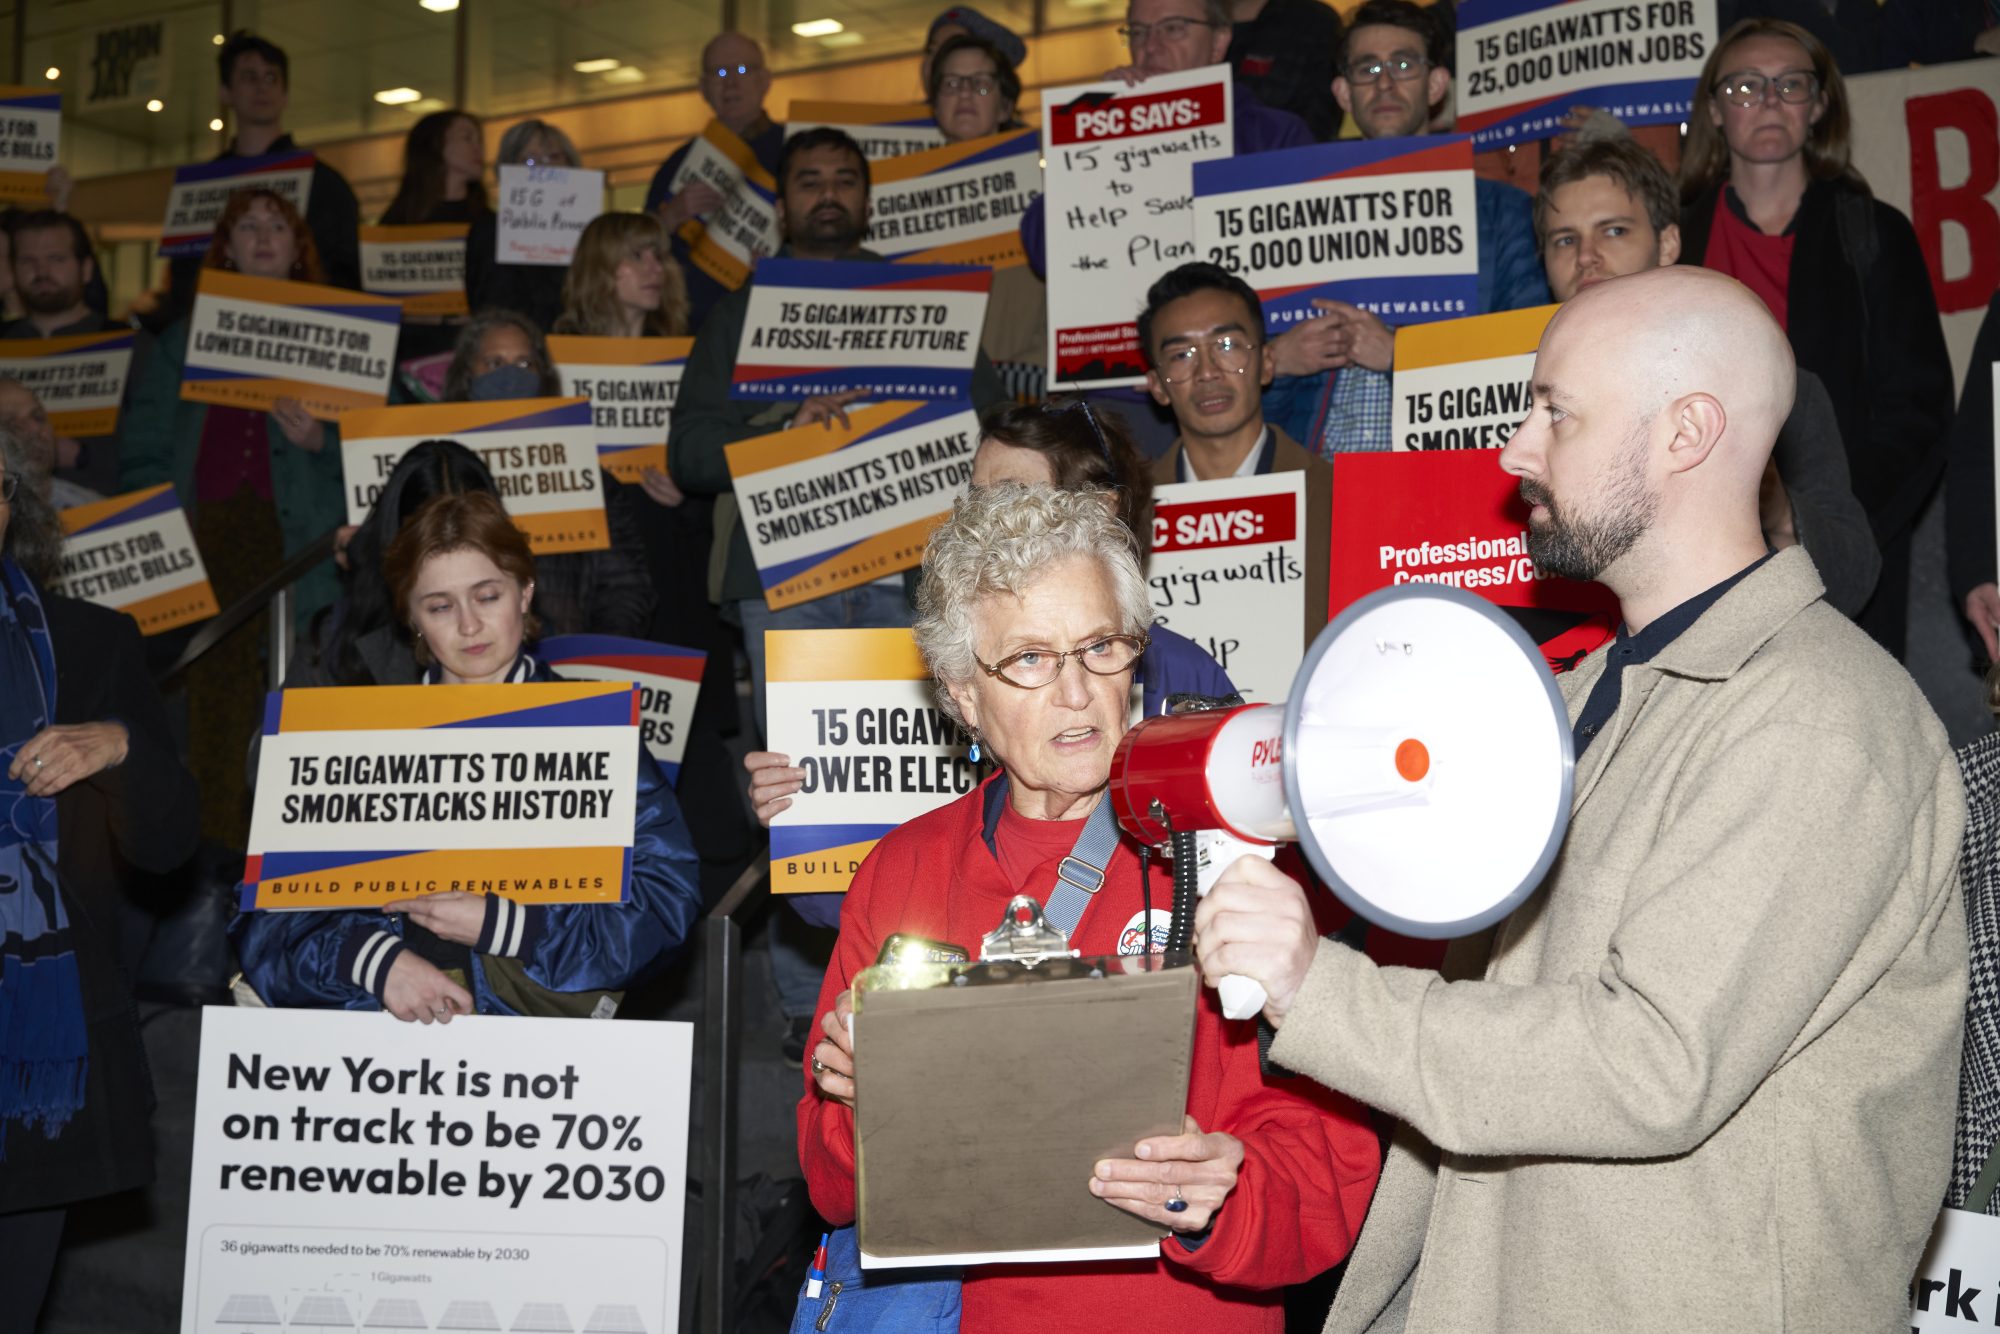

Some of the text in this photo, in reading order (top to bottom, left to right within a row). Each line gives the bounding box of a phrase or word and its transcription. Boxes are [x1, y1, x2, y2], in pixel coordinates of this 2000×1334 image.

[1476, 1, 1694, 62] 15 GIGAWATTS FOR
[1468, 33, 1705, 96] 25,000 UNION JOBS
[8, 119, 37, 138] FOR
[1075, 98, 1201, 139] PSC SAYS:
[1604, 102, 1693, 117] NEWABLE
[11, 141, 54, 160] BILLS
[1064, 131, 1220, 171] 15 gigawatts
[876, 171, 1017, 217] GIGAWATTS FOR
[1107, 180, 1133, 196] to
[904, 203, 988, 236] ELECTRIC
[1067, 206, 1127, 229] Help
[1216, 188, 1452, 238] 15 GIGAWATTS FOR
[1209, 224, 1464, 275] 25,000 UNION JOBS
[780, 303, 948, 325] 15 GIGAWATTS TO
[1270, 299, 1466, 324] PUBLI NEWABLES
[217, 310, 371, 352] 15 GIGAWATTS FOR
[752, 328, 970, 351] A FOSSIL-FREE FUTURE
[194, 332, 388, 380] LOWER ELECTRIC BILLS
[739, 382, 786, 395] BUILD
[1406, 393, 1433, 424] 15
[527, 443, 567, 468] FOR
[747, 432, 972, 517] 15 GIGAWATTS TO MAKE
[537, 468, 595, 492] BILLS
[757, 460, 974, 546] SMOKESTACKS HISTOR
[1175, 508, 1264, 546] SAYS:
[57, 531, 165, 577] WATTS FOR
[139, 548, 195, 580] BILLS
[1379, 531, 1527, 569] Professional
[774, 579, 823, 598] BUILD
[1150, 546, 1303, 606] gigawatts
[812, 708, 849, 746] 15
[289, 752, 611, 786] 15 GIGAWATTS TO MAKE
[799, 755, 894, 795] OWER
[281, 789, 615, 824] SMOKESTACKS HISTORY
[272, 876, 605, 894] BUILD PUBLIC RENEWABLES
[787, 860, 860, 875] BUILD
[227, 1052, 580, 1101] New York is not
[222, 1106, 644, 1152] on track to be 70%
[219, 1158, 666, 1209] renewable by 2030
[220, 1239, 530, 1264] 36 gigawatts needed to be 70% renewable by 2030
[1909, 1268, 1982, 1322] rk
